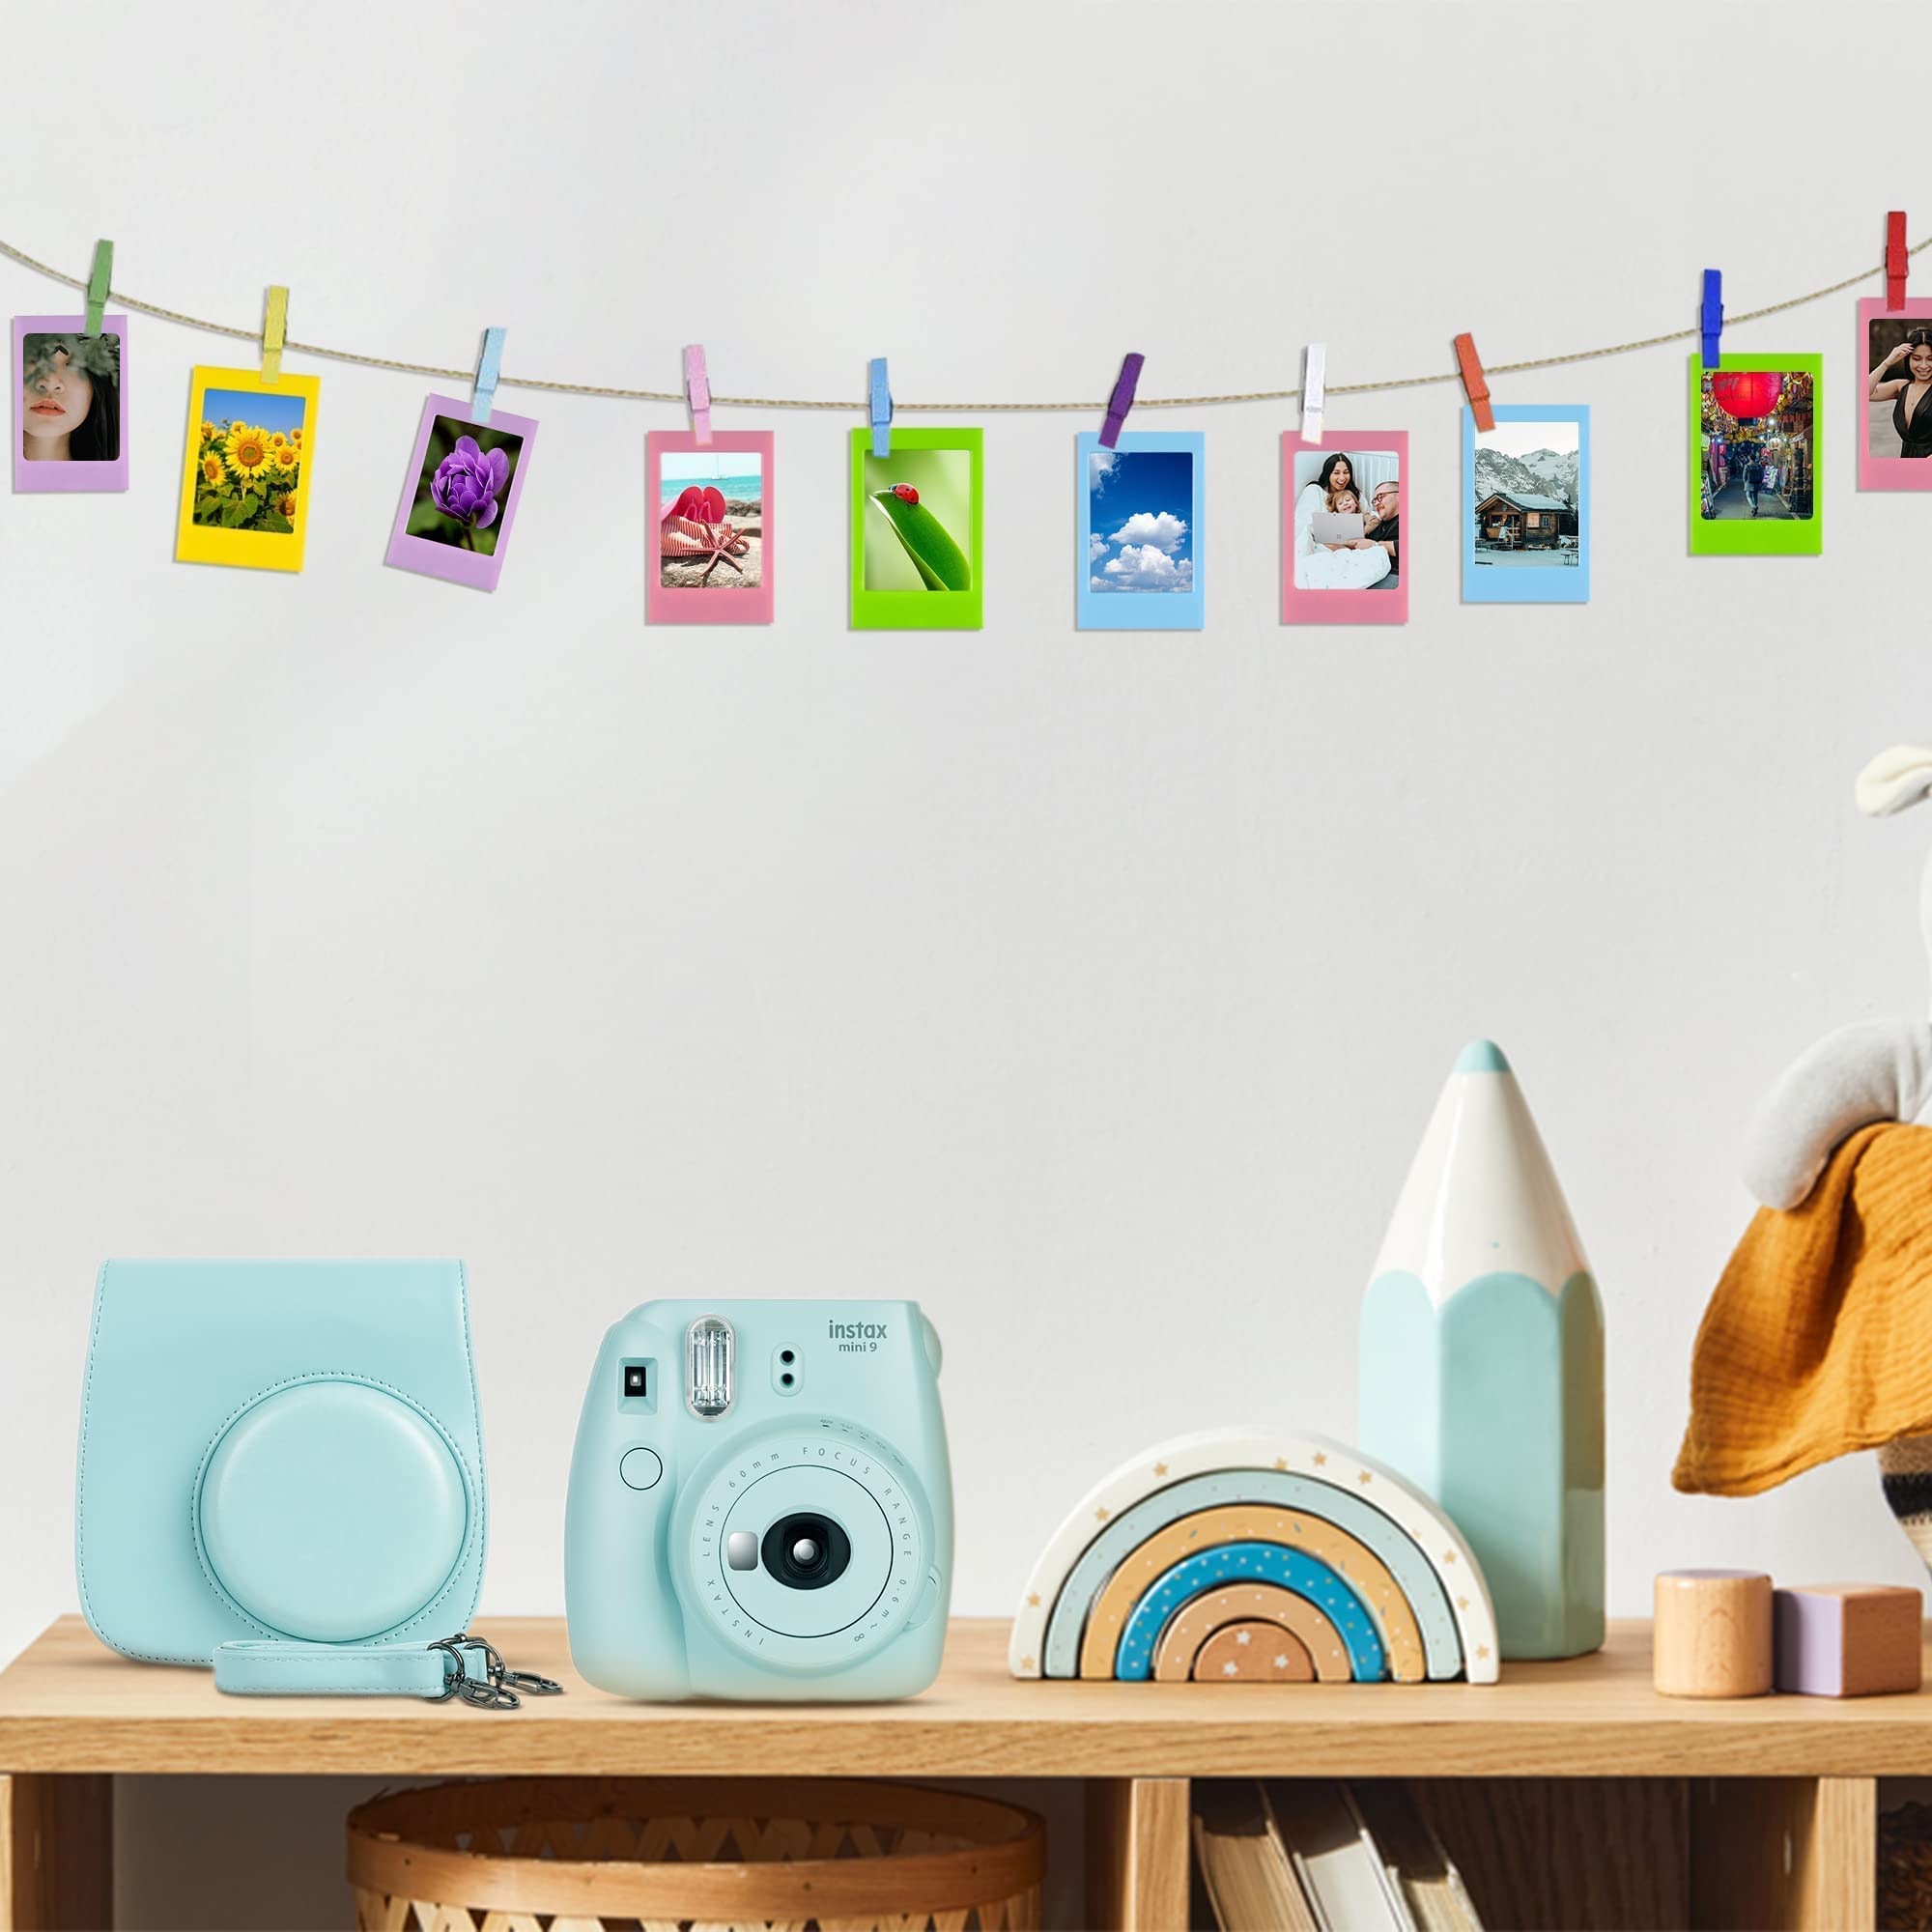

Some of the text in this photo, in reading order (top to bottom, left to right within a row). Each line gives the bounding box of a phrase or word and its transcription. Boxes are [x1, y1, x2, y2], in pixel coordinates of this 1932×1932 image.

[829, 1319, 888, 1339] instax
[838, 1341, 878, 1352] mini 9
[728, 1452, 780, 1489] 60mm
[803, 1446, 870, 1475] FOCUS
[702, 1504, 720, 1557] LENS
[883, 1488, 912, 1556] RANGE
[706, 1578, 765, 1646] INSTAX
